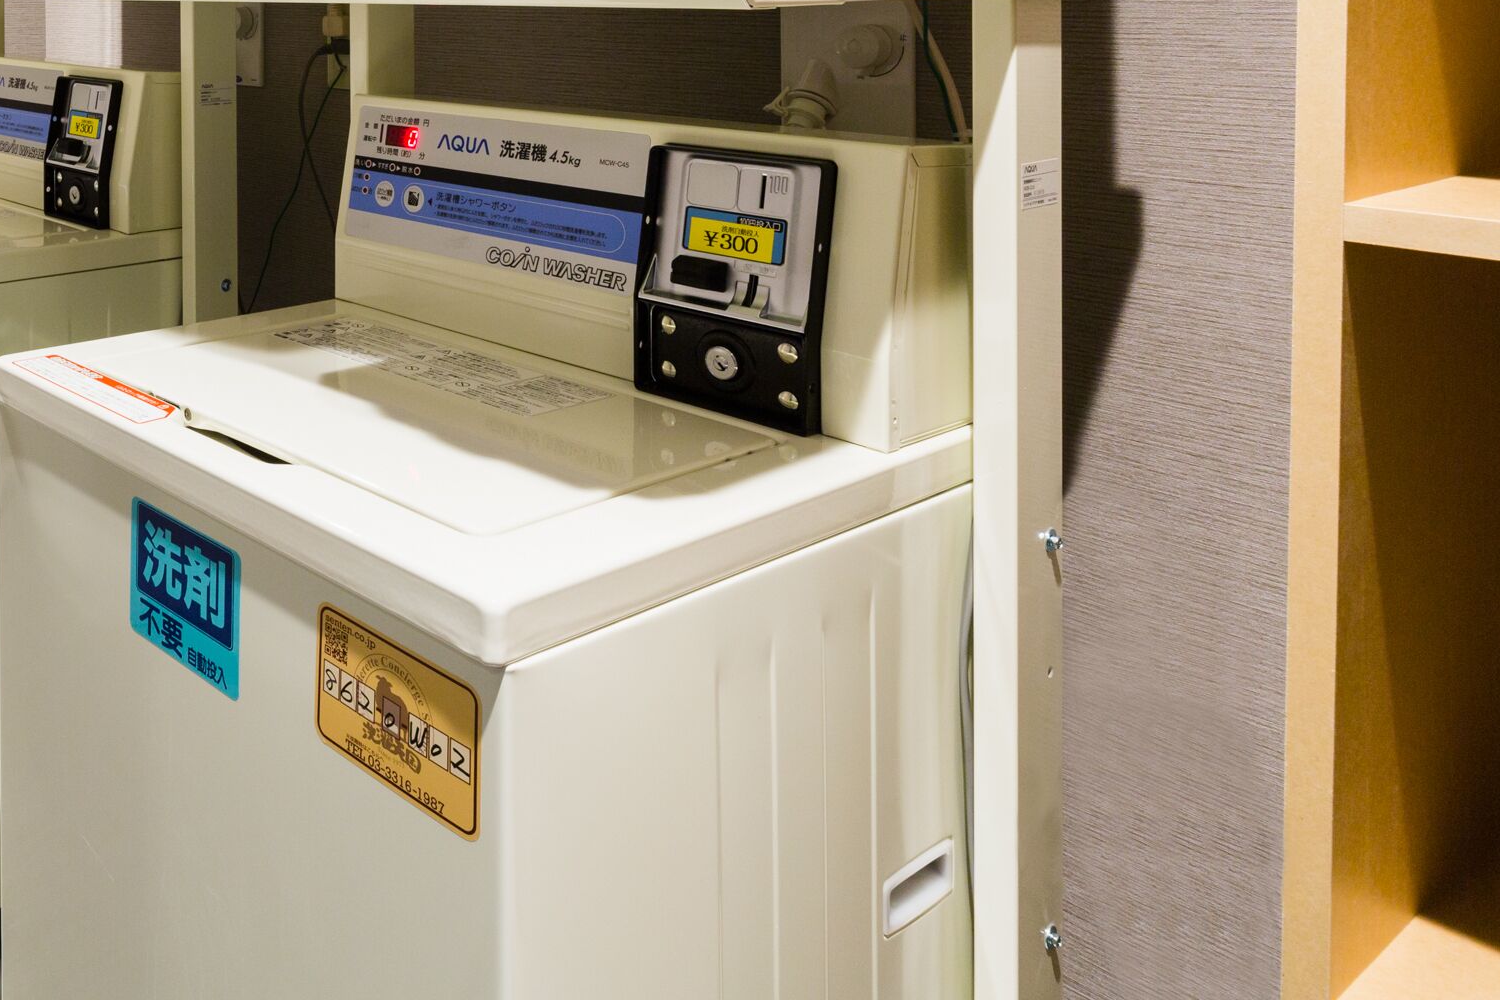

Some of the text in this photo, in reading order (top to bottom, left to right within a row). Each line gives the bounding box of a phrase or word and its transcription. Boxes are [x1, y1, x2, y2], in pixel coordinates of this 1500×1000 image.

[75, 121, 94, 135] ¥300
[407, 130, 419, 147] 0
[437, 134, 630, 168] AQUA 洗濯機 4.5kg MCW-C45
[436, 191, 517, 213] 洗濯槽シャワーボタン
[769, 175, 788, 195] 100
[703, 230, 759, 254] ¥300
[486, 246, 627, 292] COIN WASHER
[143, 519, 226, 629] 洗剤
[139, 597, 228, 690] 不要 自動投入
[325, 614, 376, 650] senten.co.jp
[380, 656, 425, 708] Concierge
[345, 737, 366, 763] TEL
[368, 754, 446, 815] 03-3316-1987
